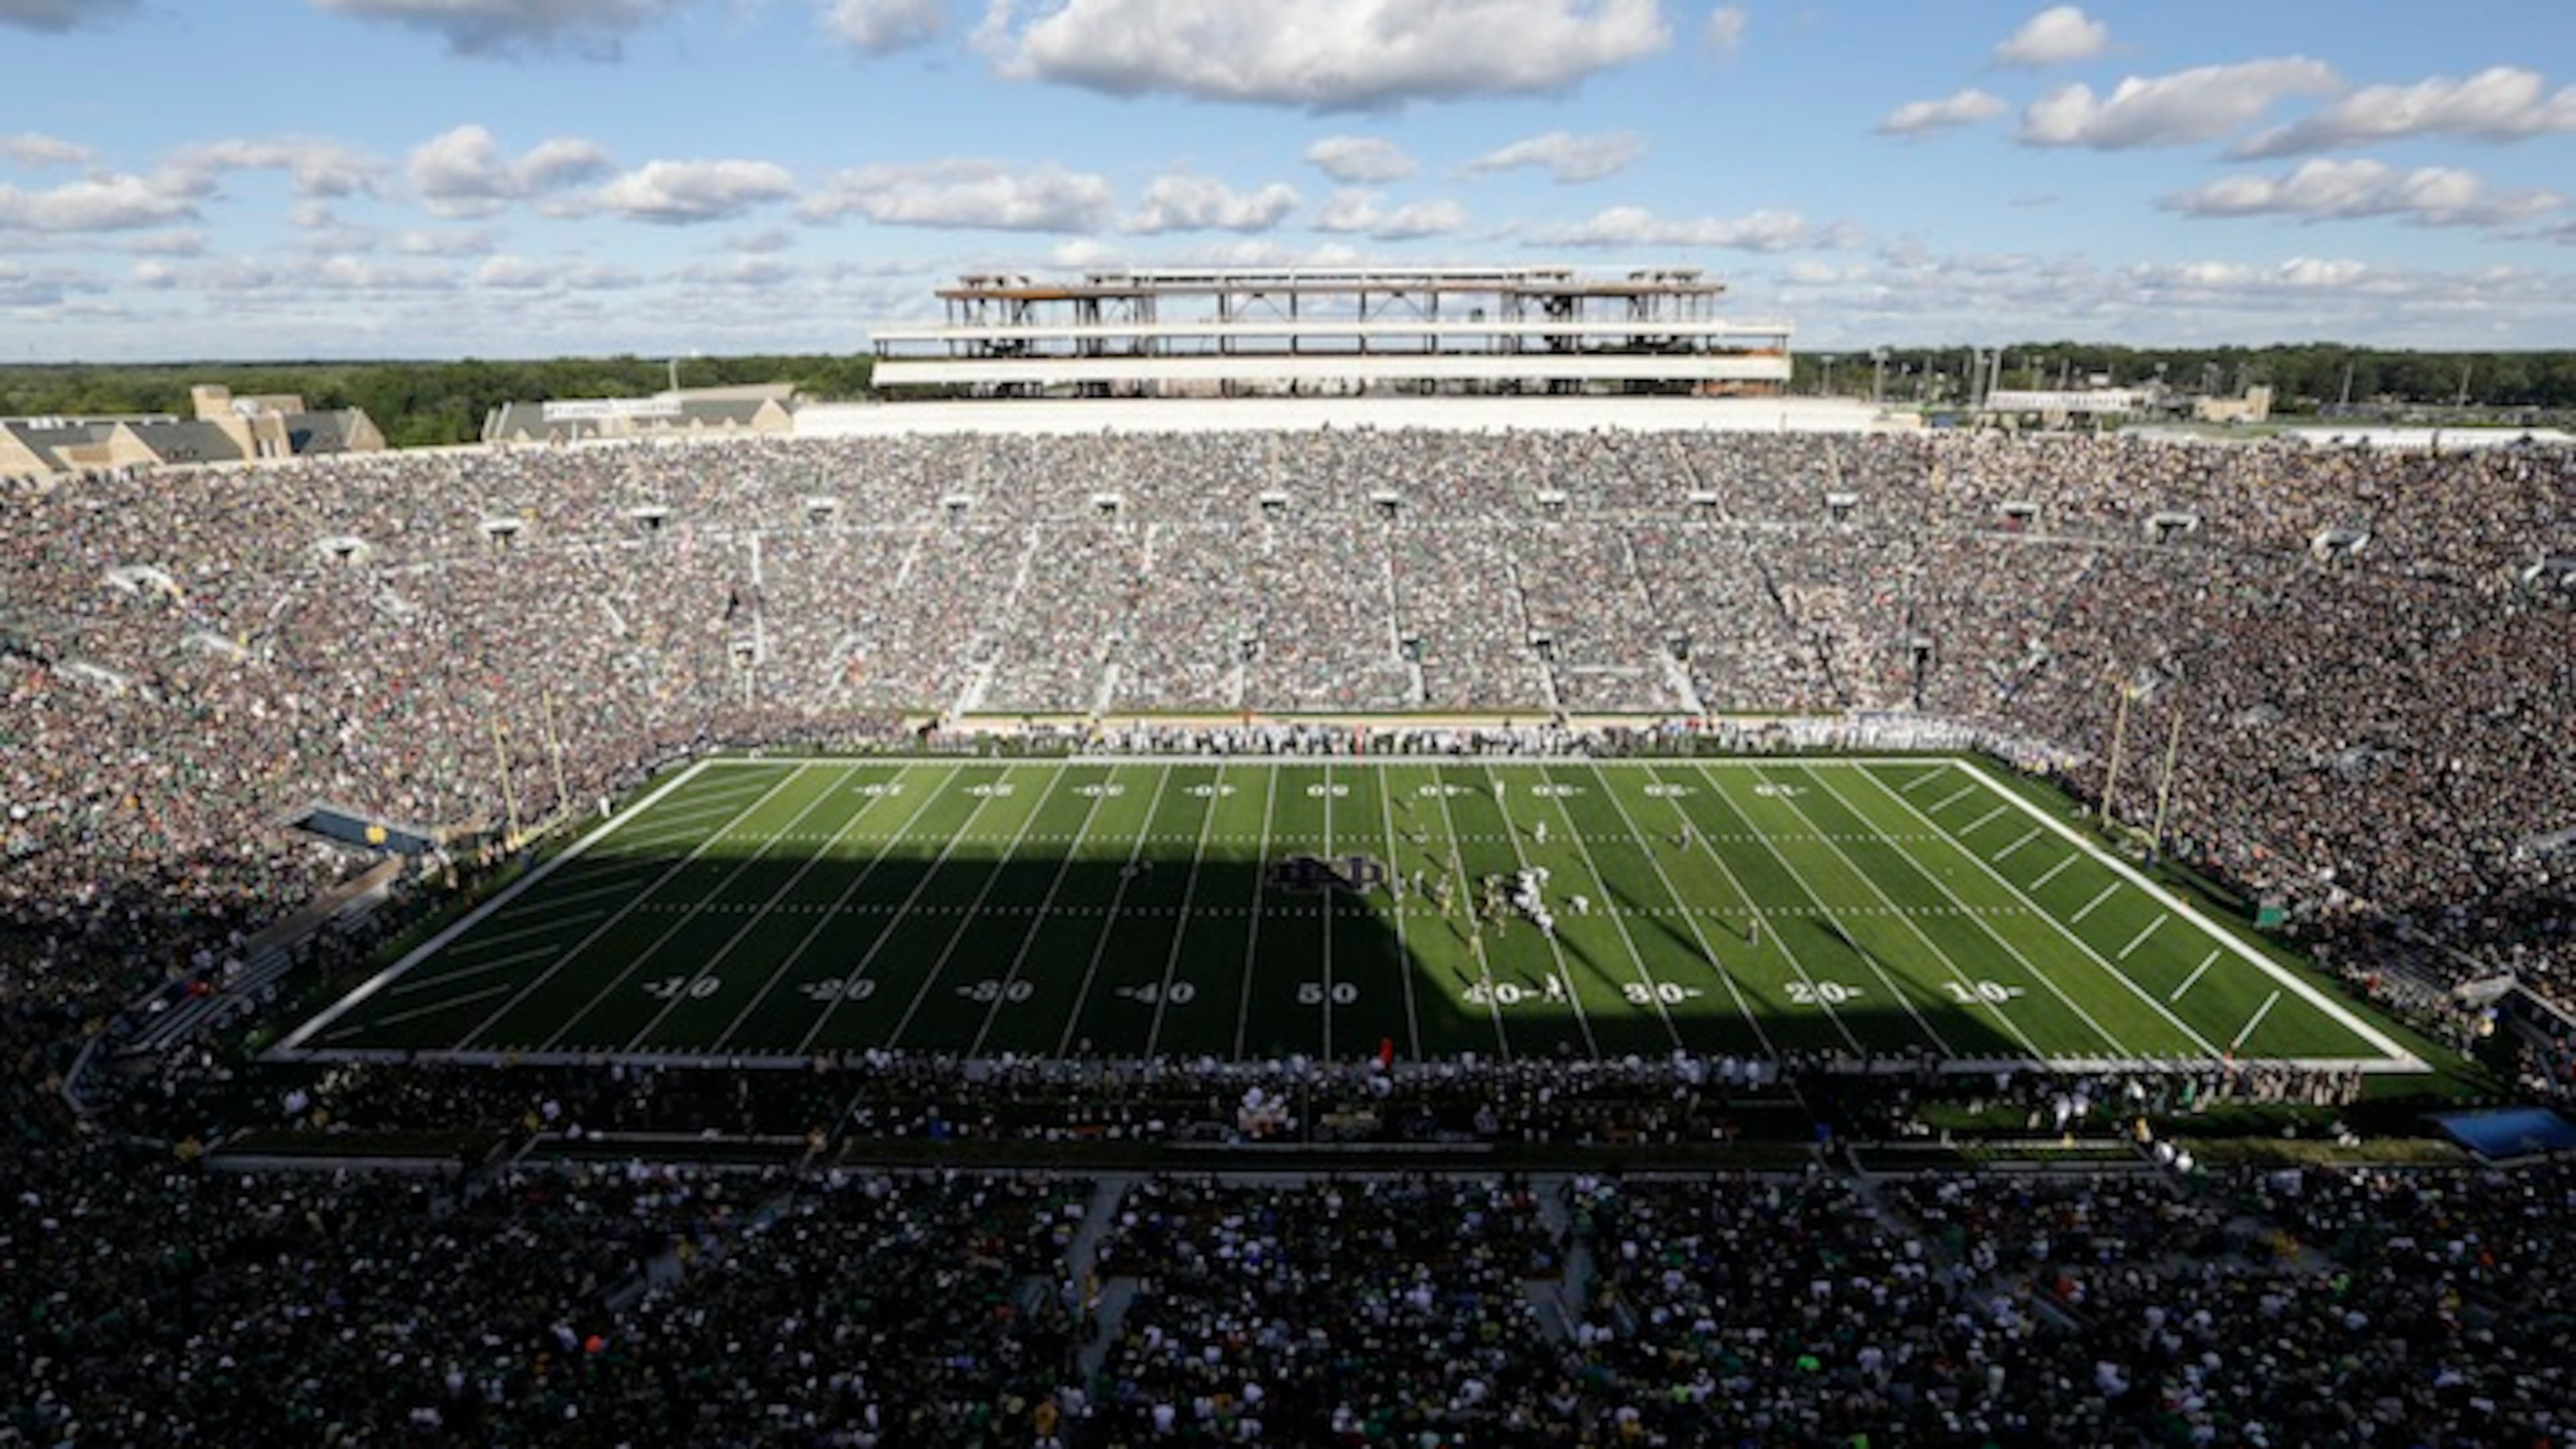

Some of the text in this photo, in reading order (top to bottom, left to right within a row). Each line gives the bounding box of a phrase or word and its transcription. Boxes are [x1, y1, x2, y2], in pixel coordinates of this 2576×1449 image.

[810, 978, 875, 1000] 20
[973, 979, 1034, 1002] 30
[1134, 981, 1195, 1004] 40
[1297, 983, 1358, 1004] 50
[1622, 982, 1684, 1004] 30
[1784, 980, 1845, 1004] 20
[1942, 980, 2010, 1004] 10
